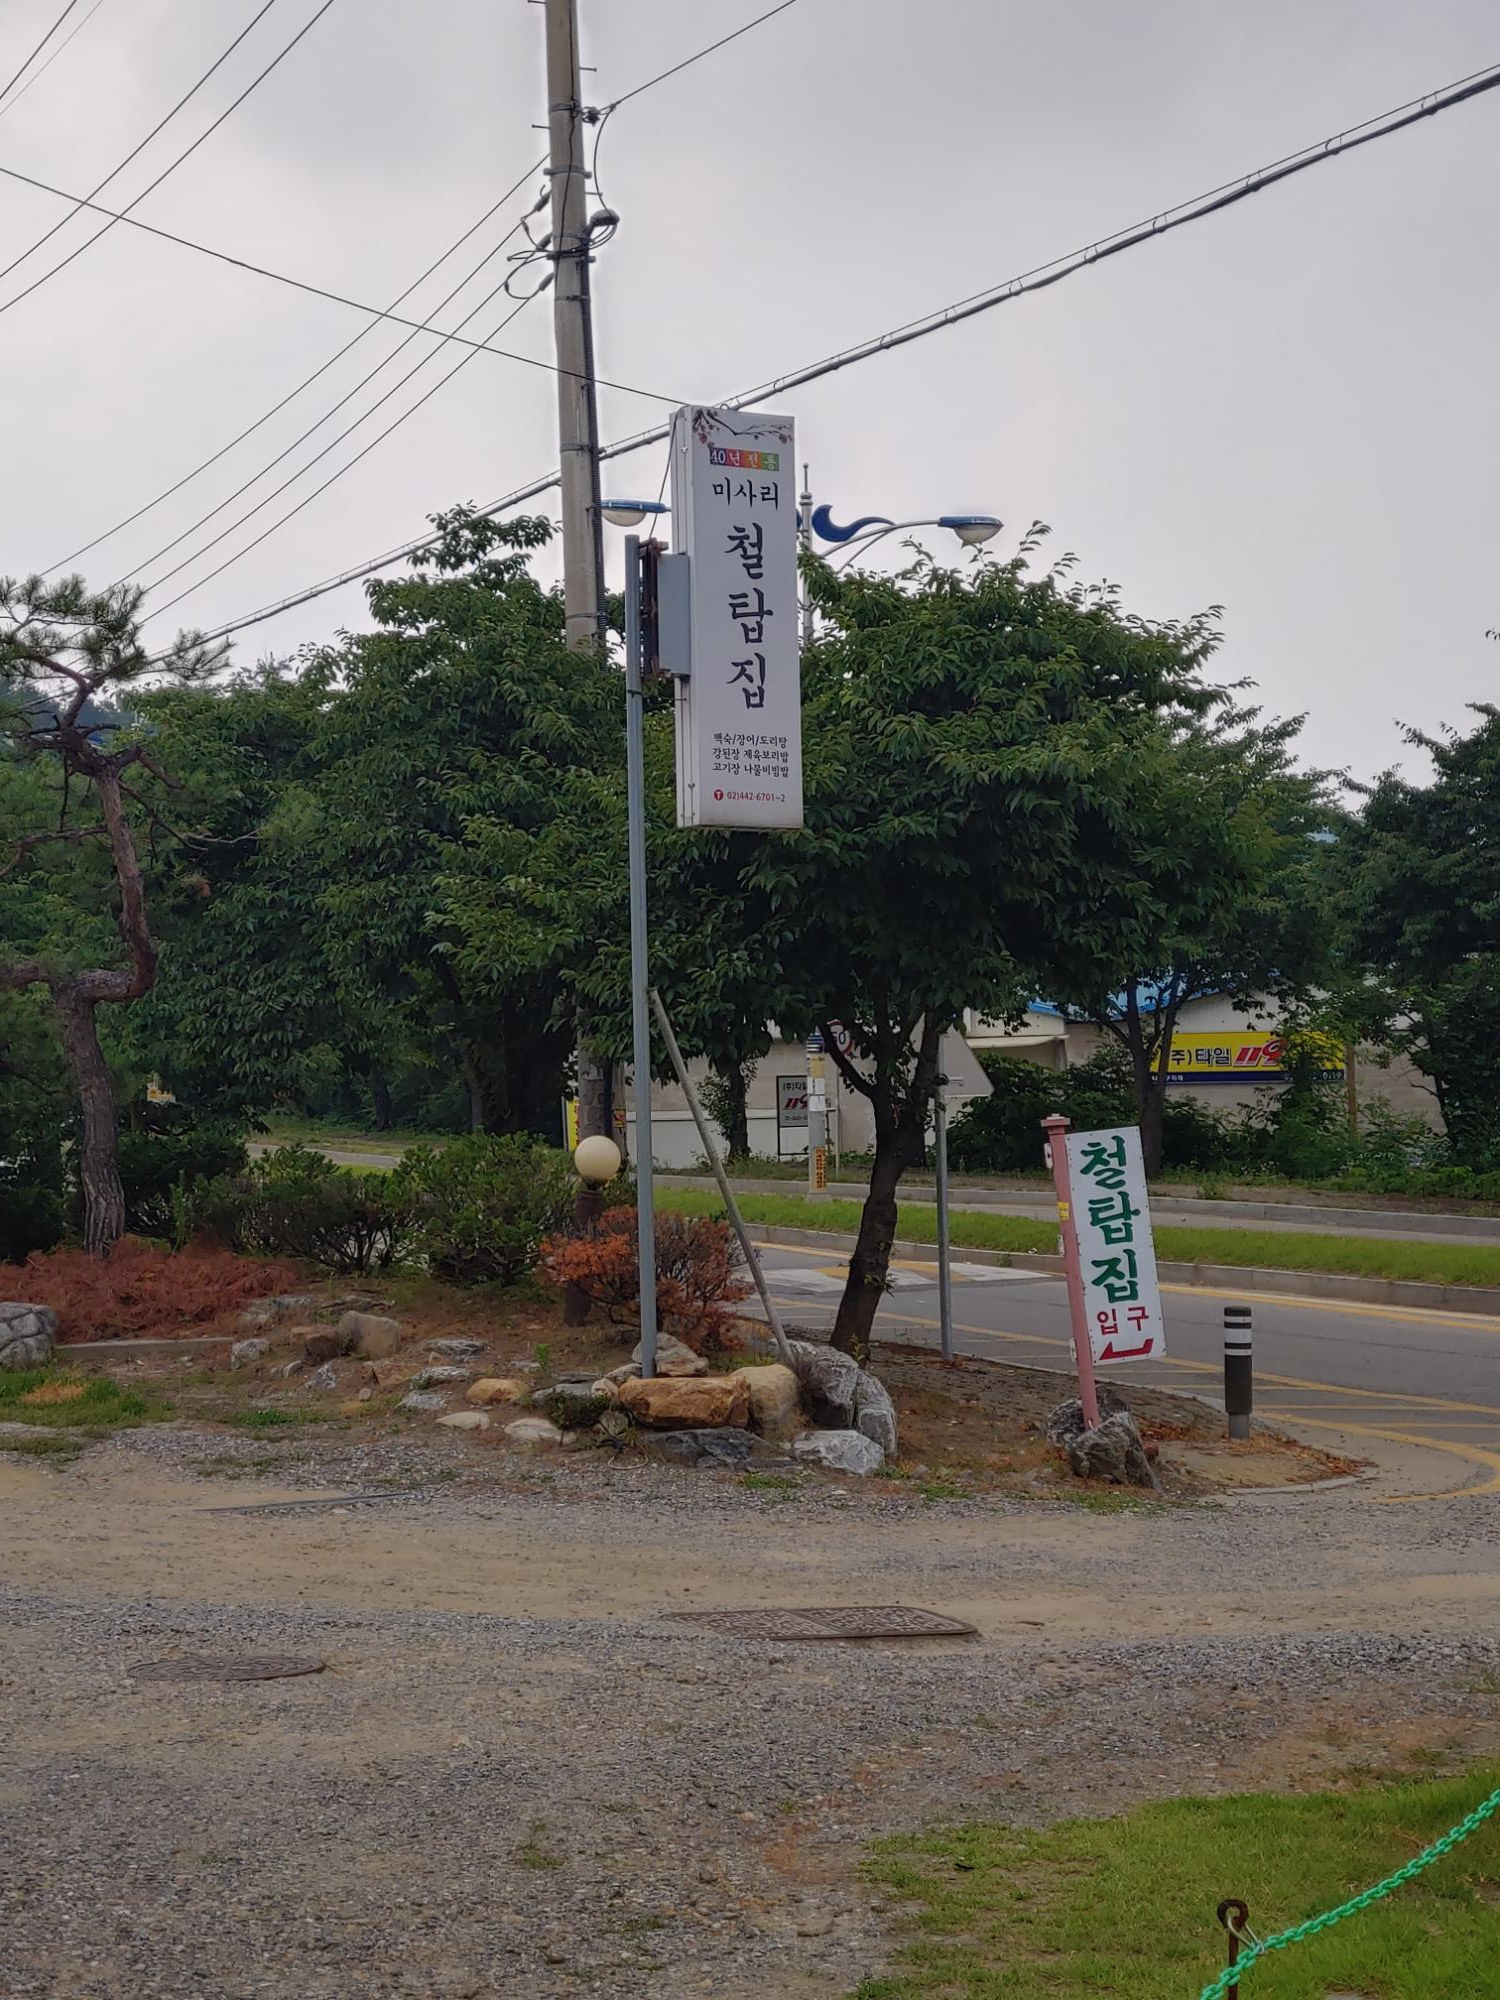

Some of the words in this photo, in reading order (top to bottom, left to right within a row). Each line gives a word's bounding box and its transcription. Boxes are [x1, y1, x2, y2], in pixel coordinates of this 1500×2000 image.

[712, 476, 779, 511] 미사리
[725, 522, 774, 709] 철탑집
[712, 747, 740, 761] 강된장
[743, 749, 789, 764] 제육보리밥
[744, 763, 789, 778] 나물비빔밥
[1171, 1047, 1232, 1067] 주)타일
[1233, 1039, 1289, 1067] 119
[1079, 1135, 1141, 1304] 철탑집
[1096, 1305, 1150, 1336] 입구
